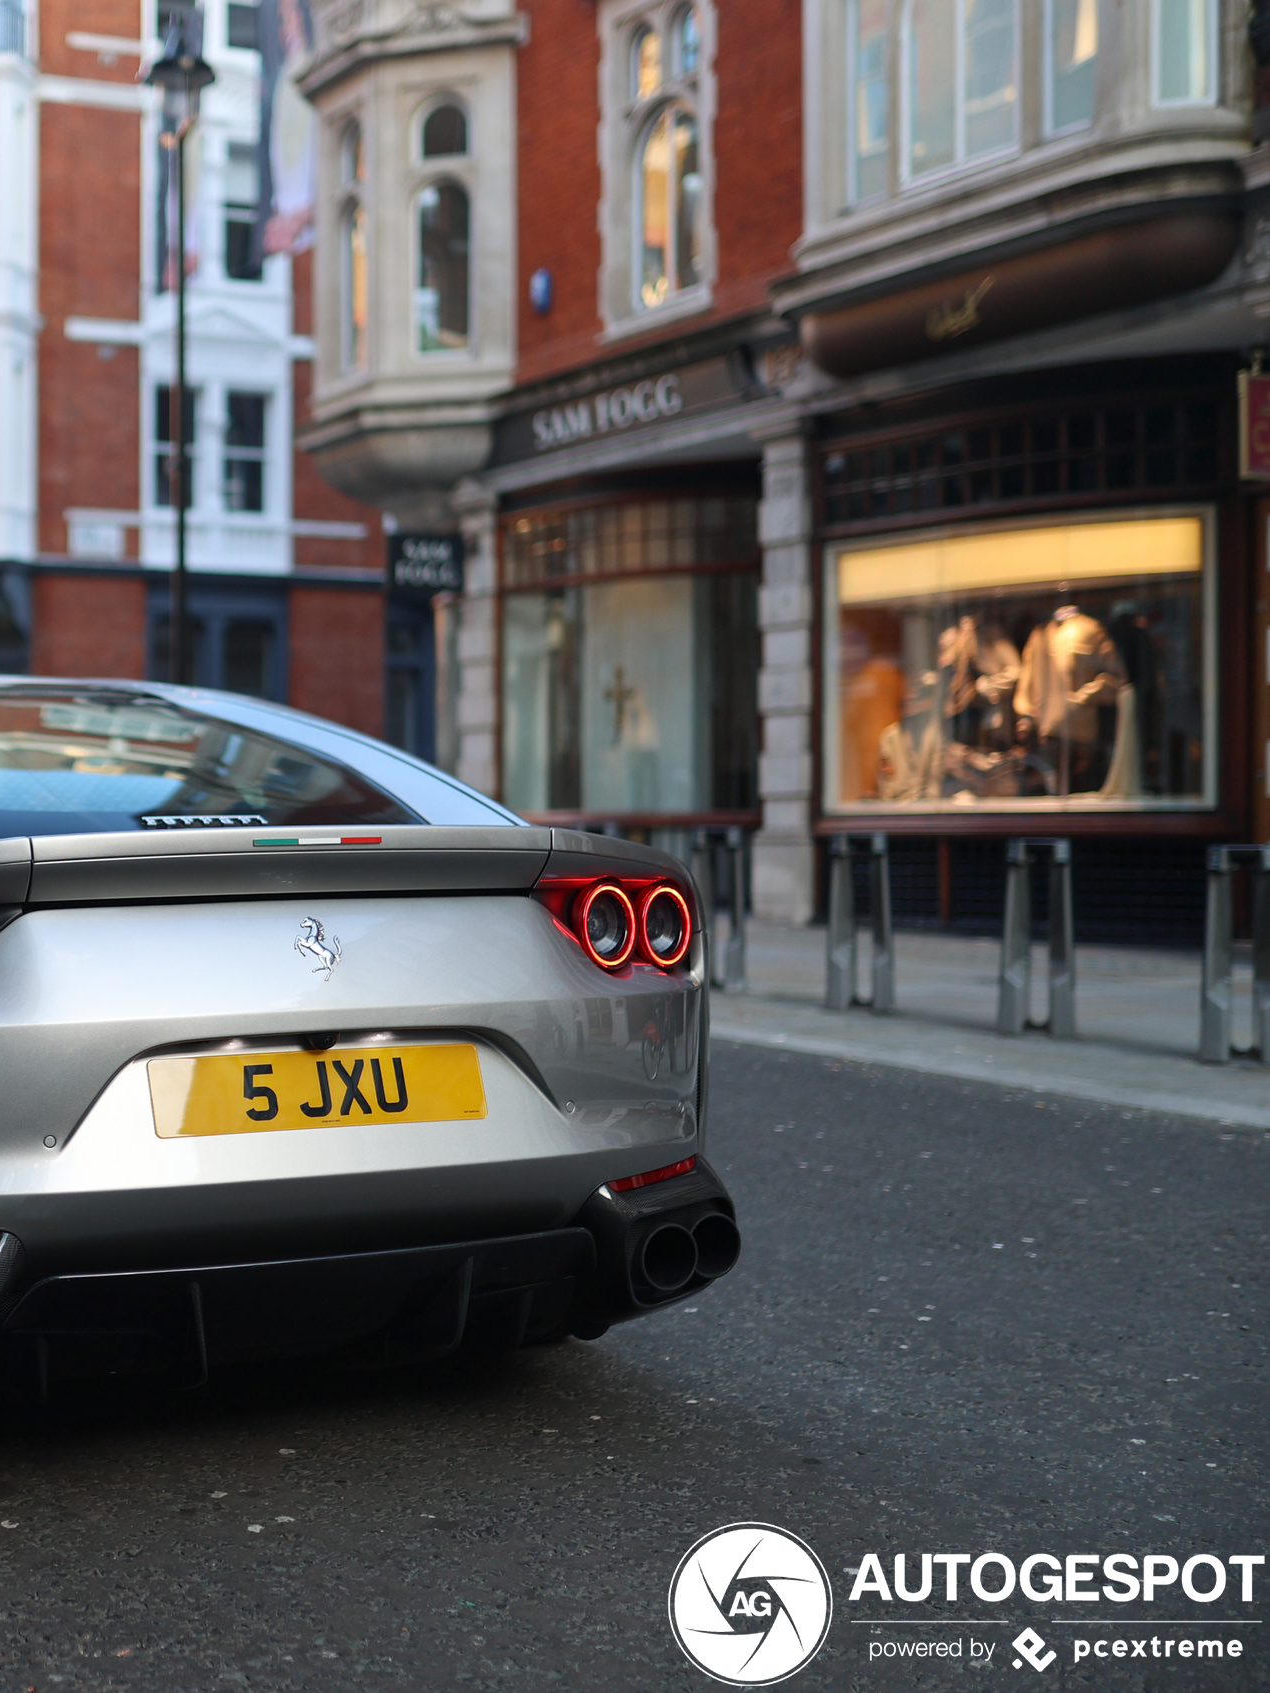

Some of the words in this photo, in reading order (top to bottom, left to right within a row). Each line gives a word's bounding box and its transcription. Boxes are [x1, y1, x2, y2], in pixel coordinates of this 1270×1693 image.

[532, 402, 593, 450] SAM
[594, 374, 683, 433] FOGG
[402, 538, 453, 561] SAM
[244, 1064, 278, 1121] 5
[300, 1058, 408, 1117] JXU
